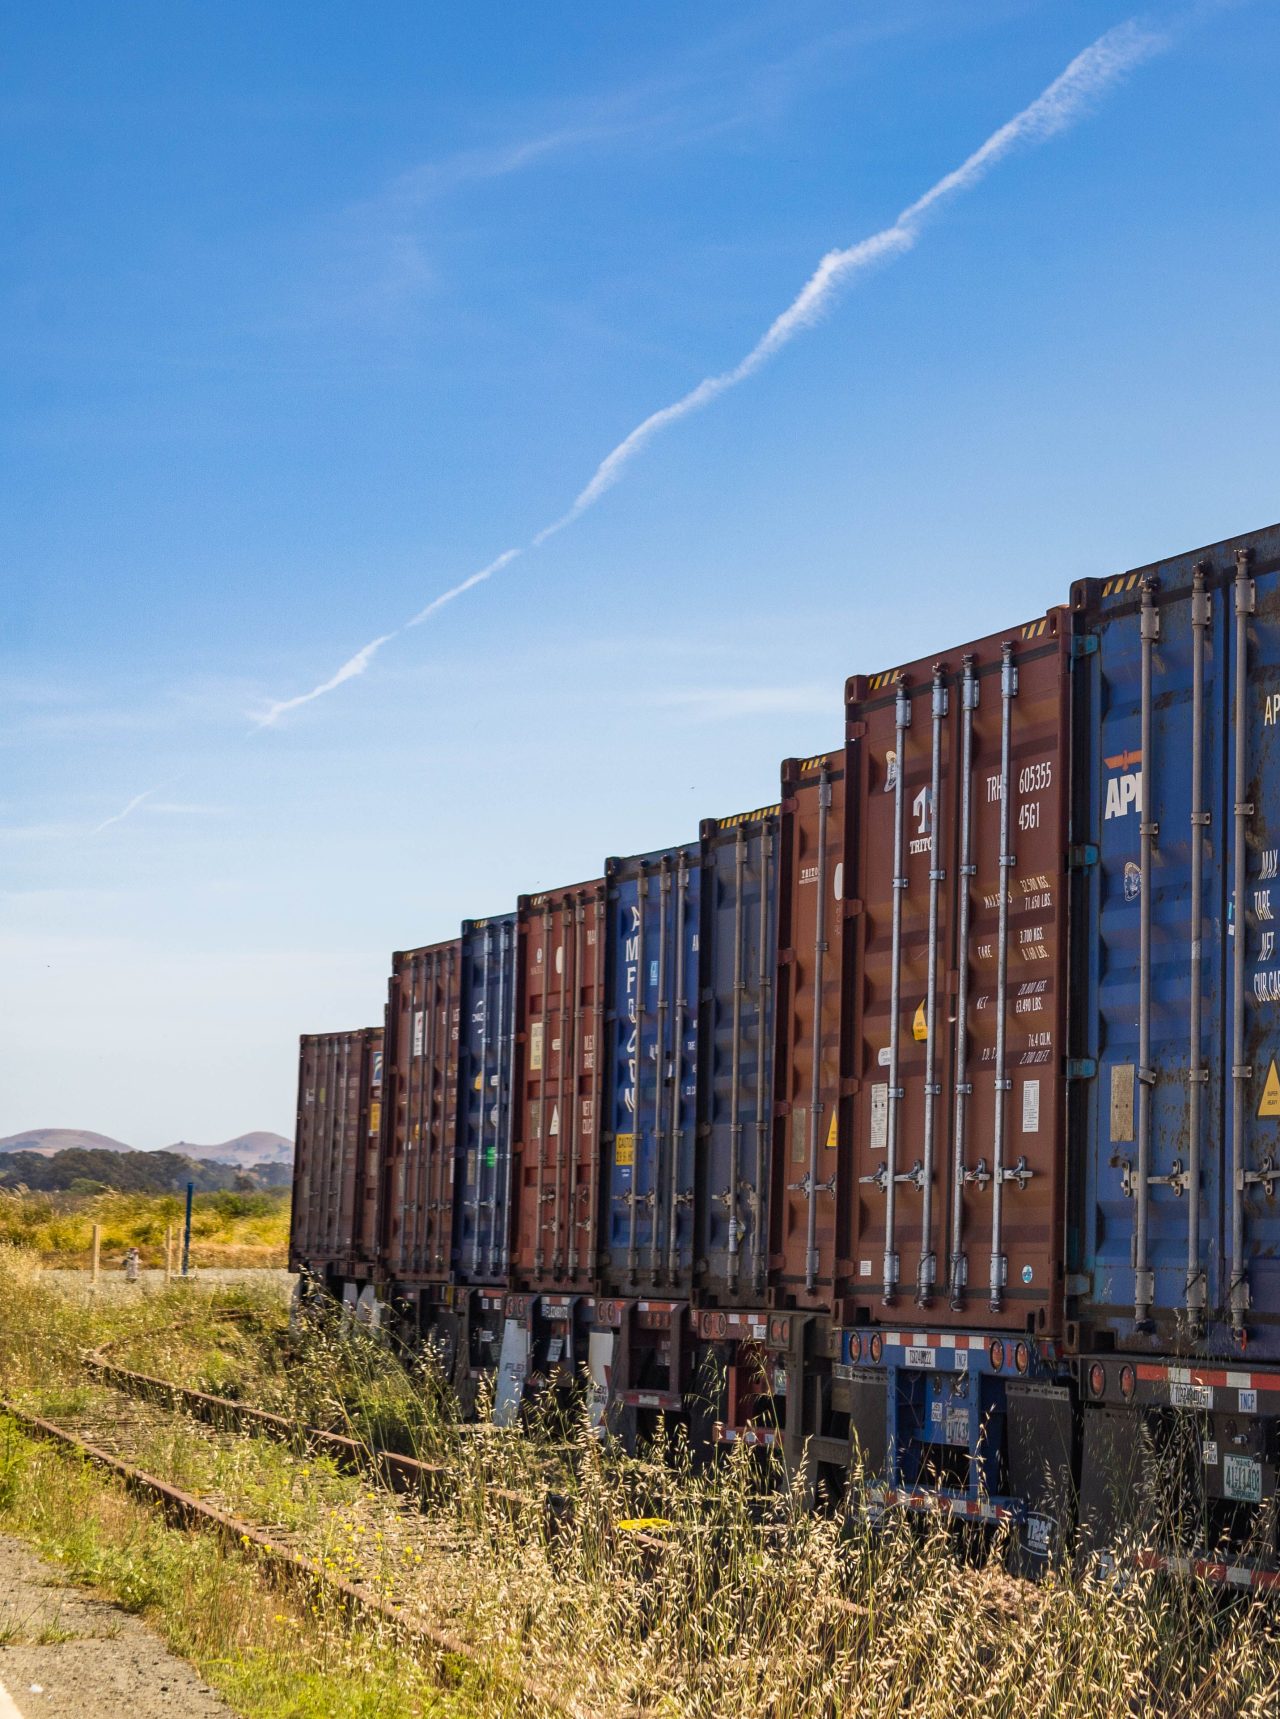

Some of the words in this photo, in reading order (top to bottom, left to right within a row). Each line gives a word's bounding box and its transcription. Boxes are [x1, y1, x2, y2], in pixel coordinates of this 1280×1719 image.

[987, 774, 1003, 803] TRH
[1019, 762, 1052, 794] 605355
[1019, 802, 1040, 831] 45G1
[909, 836, 932, 855] TRITO
[1254, 889, 1274, 921] TARE
